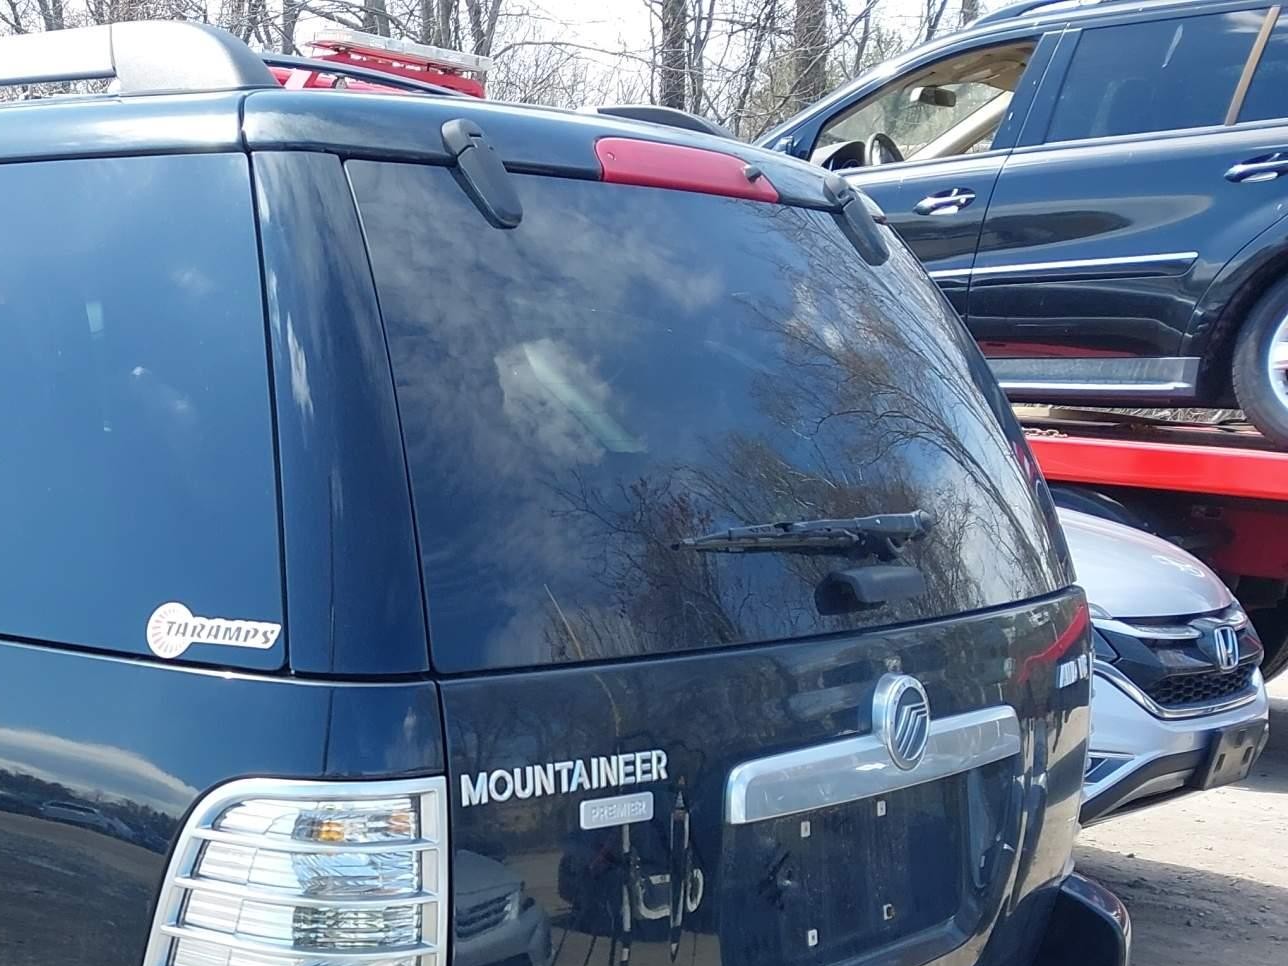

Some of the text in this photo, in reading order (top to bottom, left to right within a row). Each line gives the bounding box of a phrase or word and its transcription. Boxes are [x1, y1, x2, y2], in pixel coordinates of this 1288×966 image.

[166, 620, 275, 645] TARAMPS
[461, 749, 668, 808] MOUNTAINEER
[591, 800, 648, 822] PREMIER
